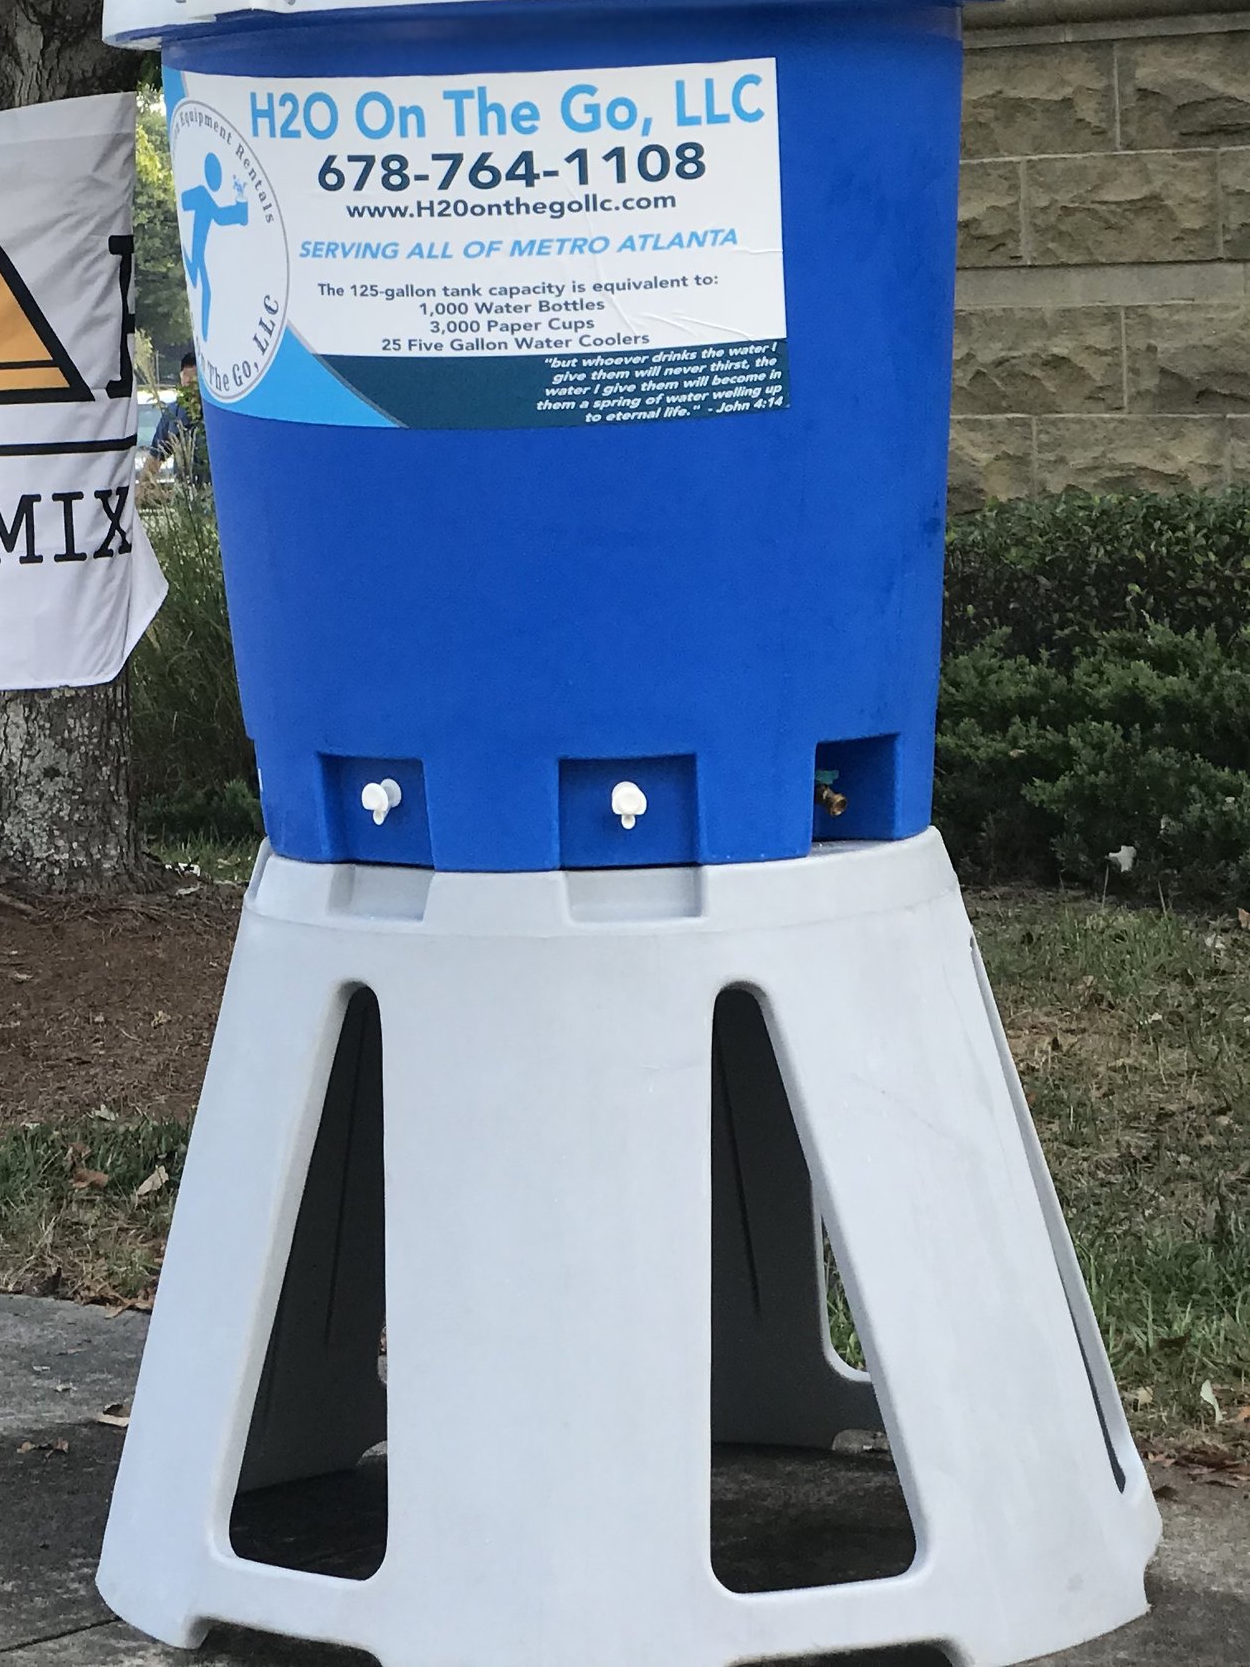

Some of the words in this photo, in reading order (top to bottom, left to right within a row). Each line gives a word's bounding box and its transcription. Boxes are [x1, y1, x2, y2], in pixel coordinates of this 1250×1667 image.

[250, 91, 339, 140] H2O
[355, 91, 426, 140] On
[442, 86, 540, 137] The
[560, 83, 653, 137] Go,
[675, 73, 765, 127] LLC
[179, 107, 232, 145] Equipment
[235, 143, 275, 224] Rentals
[318, 141, 706, 192] 678-764-1108
[299, 240, 399, 259] SERVING
[406, 241, 453, 259] ALL
[463, 239, 503, 259] OF
[509, 236, 610, 257] METRO
[616, 228, 738, 252] ATLANTA
[317, 283, 344, 296] The
[350, 283, 436, 300] 125-gallon
[441, 283, 482, 297] tank
[488, 281, 565, 299] capacity
[572, 280, 586, 293] is
[592, 275, 689, 295] equivalent
[694, 273, 719, 286] to:
[419, 302, 469, 317] 1,000
[474, 301, 532, 314] Water
[538, 298, 605, 313] Bottles
[252, 294, 279, 356] LLC
[430, 320, 481, 335] 3,000
[487, 319, 541, 335] Paper
[548, 317, 595, 332] Cups
[381, 338, 402, 351] 25
[408, 337, 444, 352] Five
[449, 337, 509, 352] Gallon
[514, 336, 572, 350] Water
[578, 332, 650, 348] Coolers
[582, 355, 649, 368] whoever
[651, 348, 697, 363] drinks
[701, 346, 725, 360] the
[728, 344, 770, 357] water
[545, 385, 591, 397] water
[602, 382, 637, 397] give
[640, 379, 679, 392] them
[683, 375, 709, 389] will
[711, 371, 767, 387] become
[769, 369, 782, 381] in
[552, 370, 587, 384] give
[591, 367, 629, 381] them
[634, 364, 661, 379] will
[663, 363, 707, 377] never
[709, 358, 751, 373] thirst,
[755, 355, 778, 369] the
[536, 398, 576, 411] them
[579, 400, 589, 409] a
[592, 395, 642, 411] spring
[645, 392, 664, 406] of
[665, 391, 709, 404] water
[712, 385, 762, 401] welling
[764, 383, 783, 396] up
[585, 410, 601, 423] to
[605, 407, 661, 422] eternal
[715, 401, 751, 414] John
[753, 396, 784, 409] 4:14
